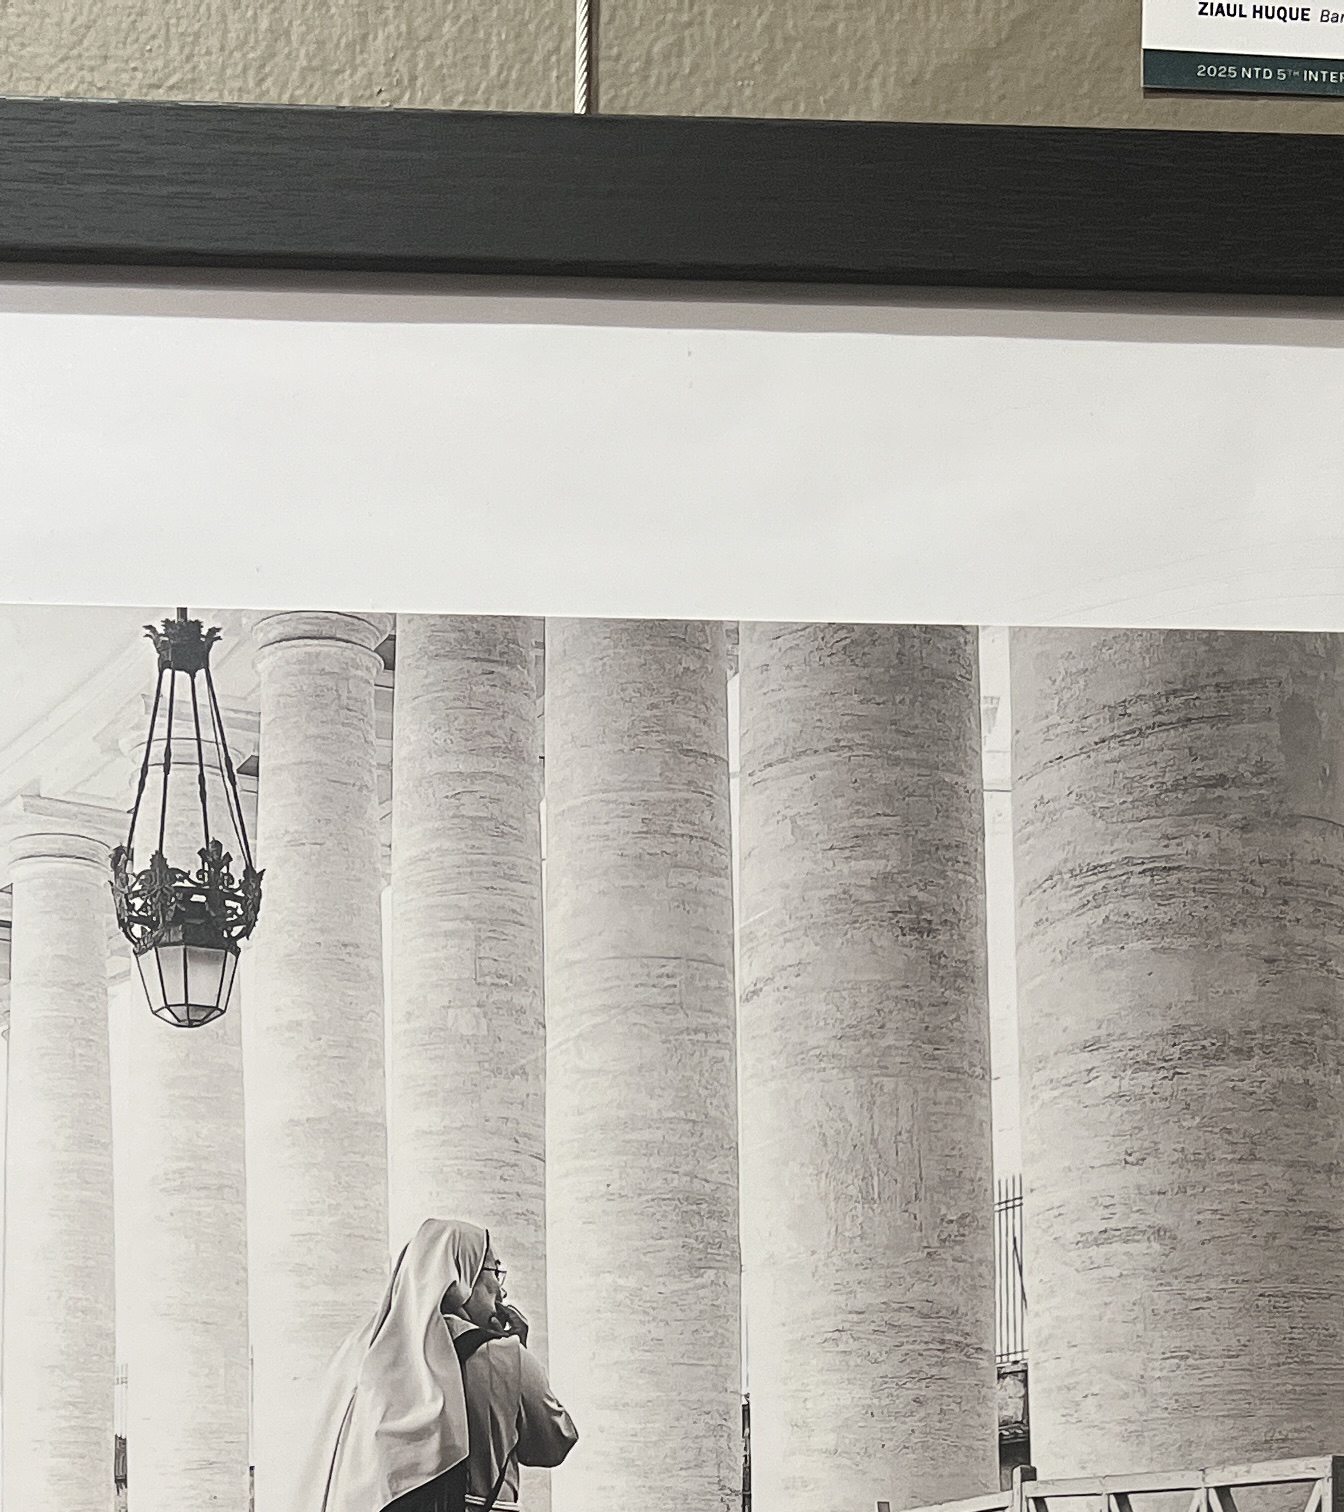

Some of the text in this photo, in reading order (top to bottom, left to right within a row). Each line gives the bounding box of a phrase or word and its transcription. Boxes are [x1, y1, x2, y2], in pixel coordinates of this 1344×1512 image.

[1198, 2, 1247, 18] ZIAUL
[1253, 5, 1311, 22] HUQUE
[1196, 65, 1237, 78] 2025
[1241, 67, 1273, 80] NTD
